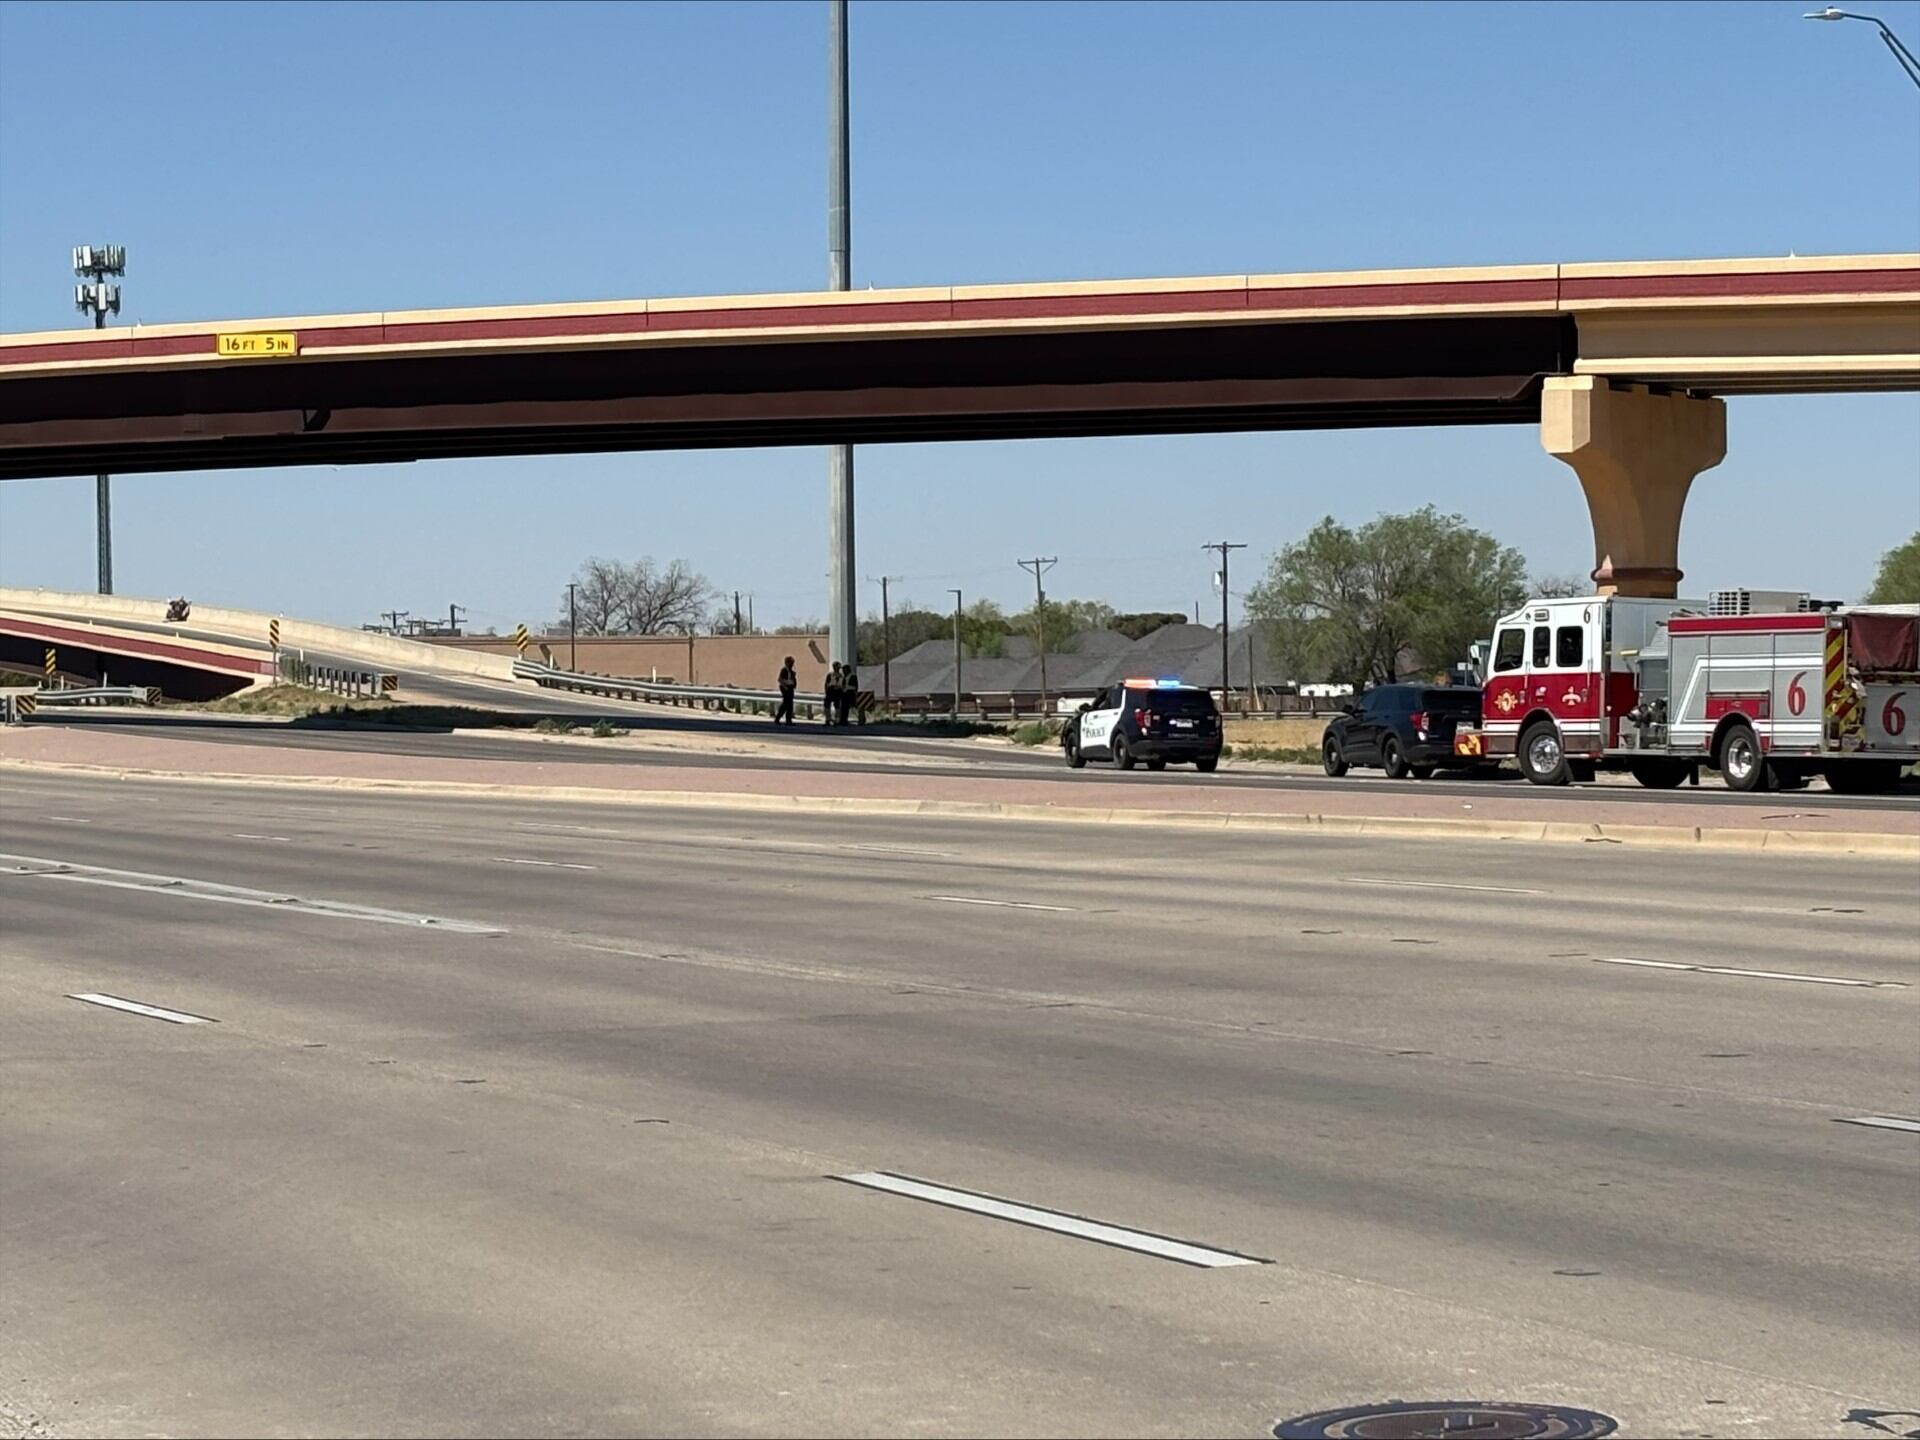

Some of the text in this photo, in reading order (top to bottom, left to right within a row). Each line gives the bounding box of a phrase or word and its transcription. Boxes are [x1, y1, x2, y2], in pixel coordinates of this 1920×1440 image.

[225, 337, 288, 351] 16 FT 5 IN
[1583, 604, 1591, 624] 6
[1787, 671, 1808, 717] 6
[1882, 691, 1907, 737] 6
